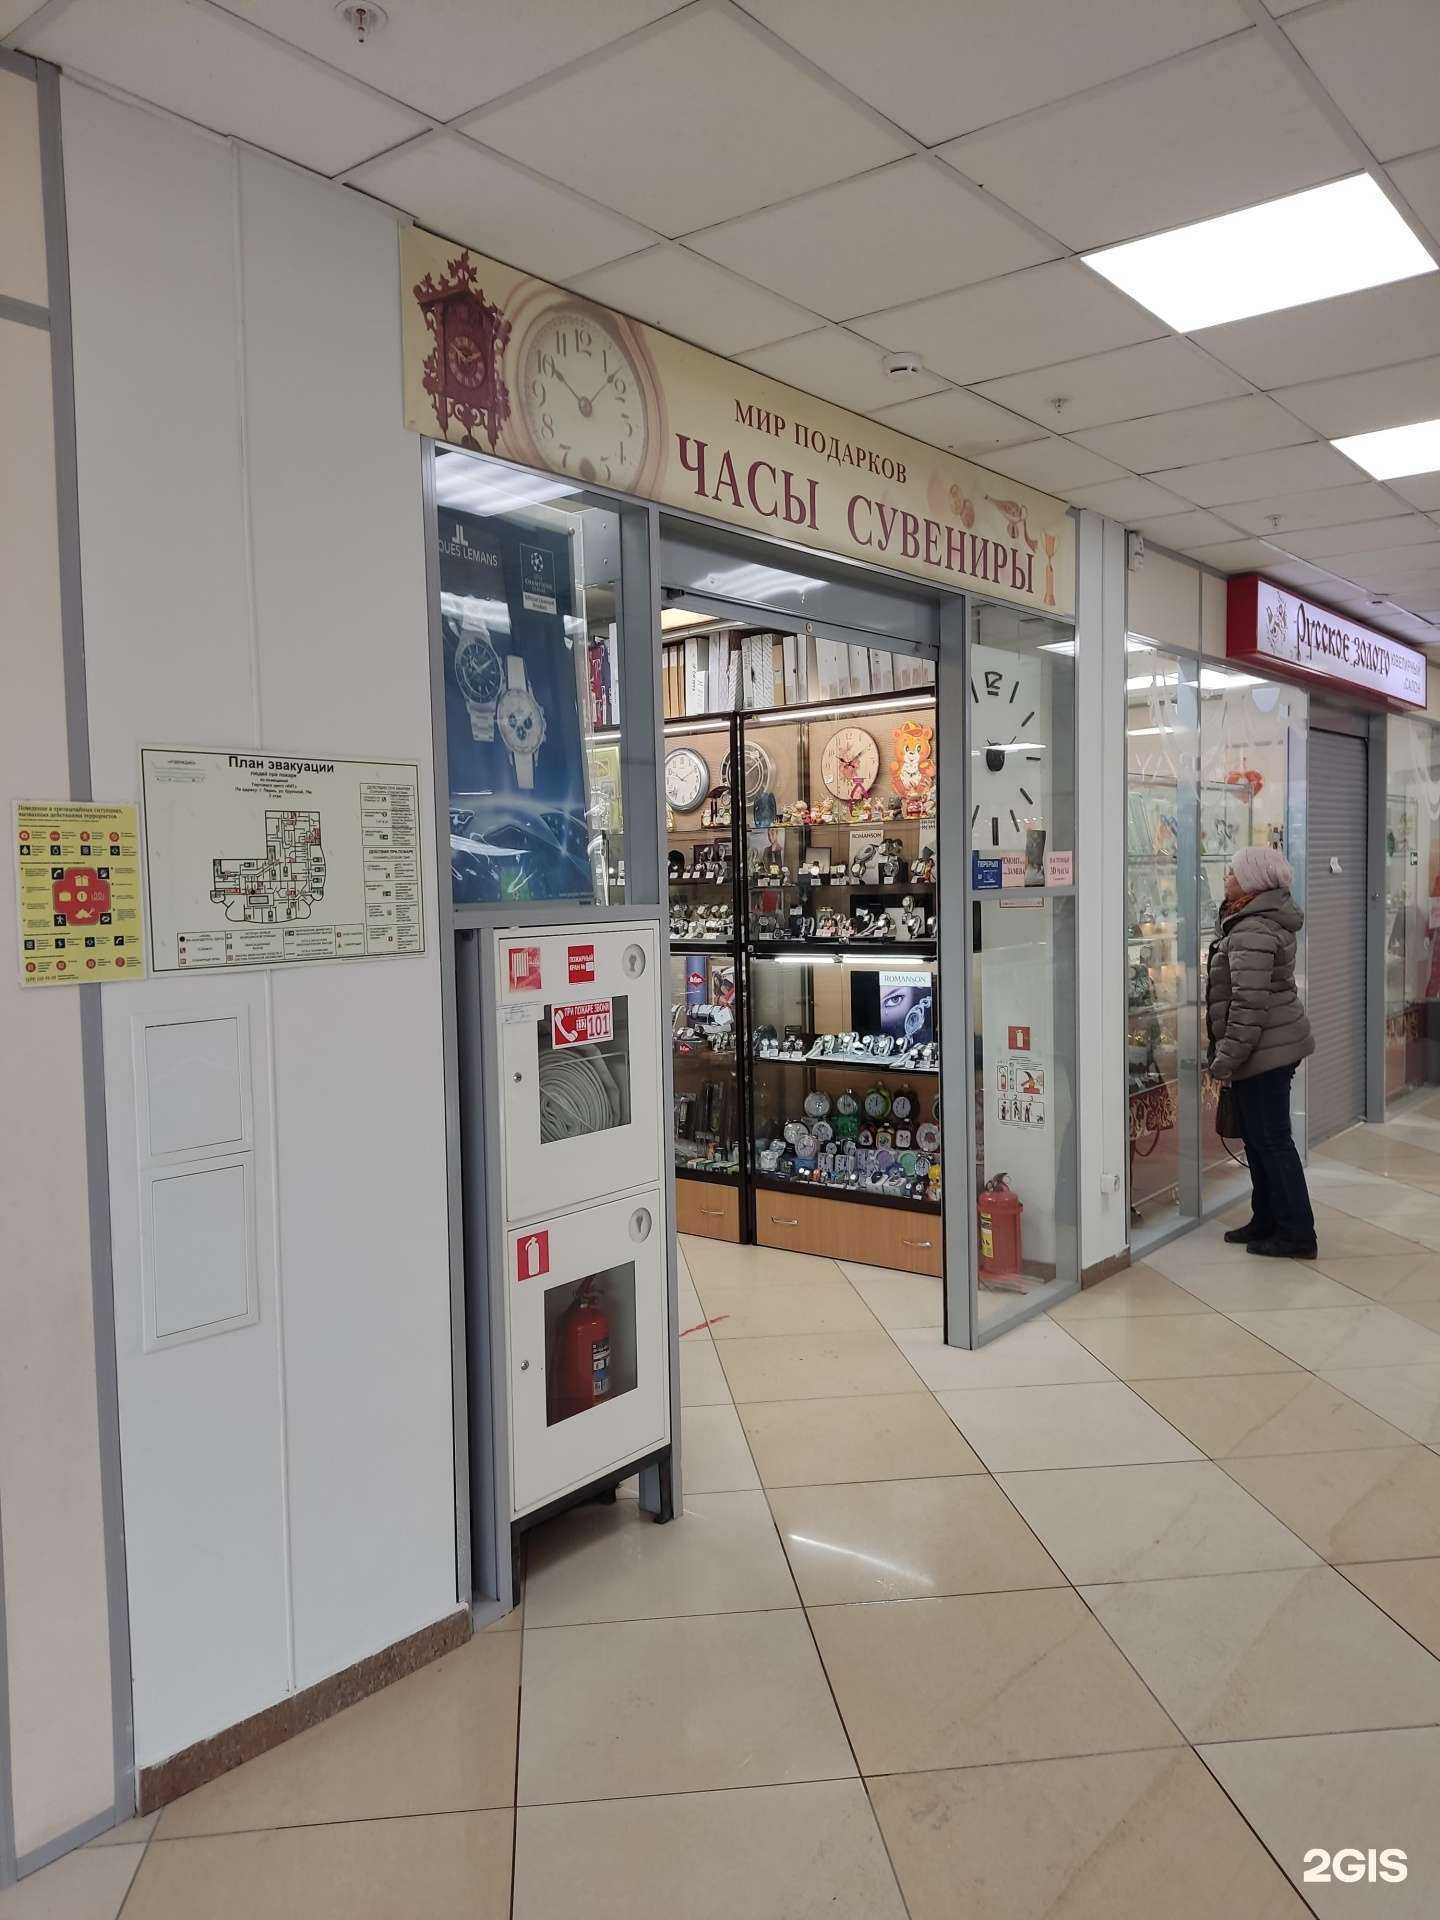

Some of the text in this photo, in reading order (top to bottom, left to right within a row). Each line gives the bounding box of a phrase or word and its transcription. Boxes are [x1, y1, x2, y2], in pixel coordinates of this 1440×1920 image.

[735, 399, 907, 484] МИР ПОДАРКОВ
[675, 433, 1034, 594] ЧАСЫ СУВЕНИРЫ
[464, 547, 498, 567] LEMANS
[228, 755, 335, 774] План эвакуации
[884, 975, 927, 983] ROMANSON
[588, 1015, 609, 1037] 101
